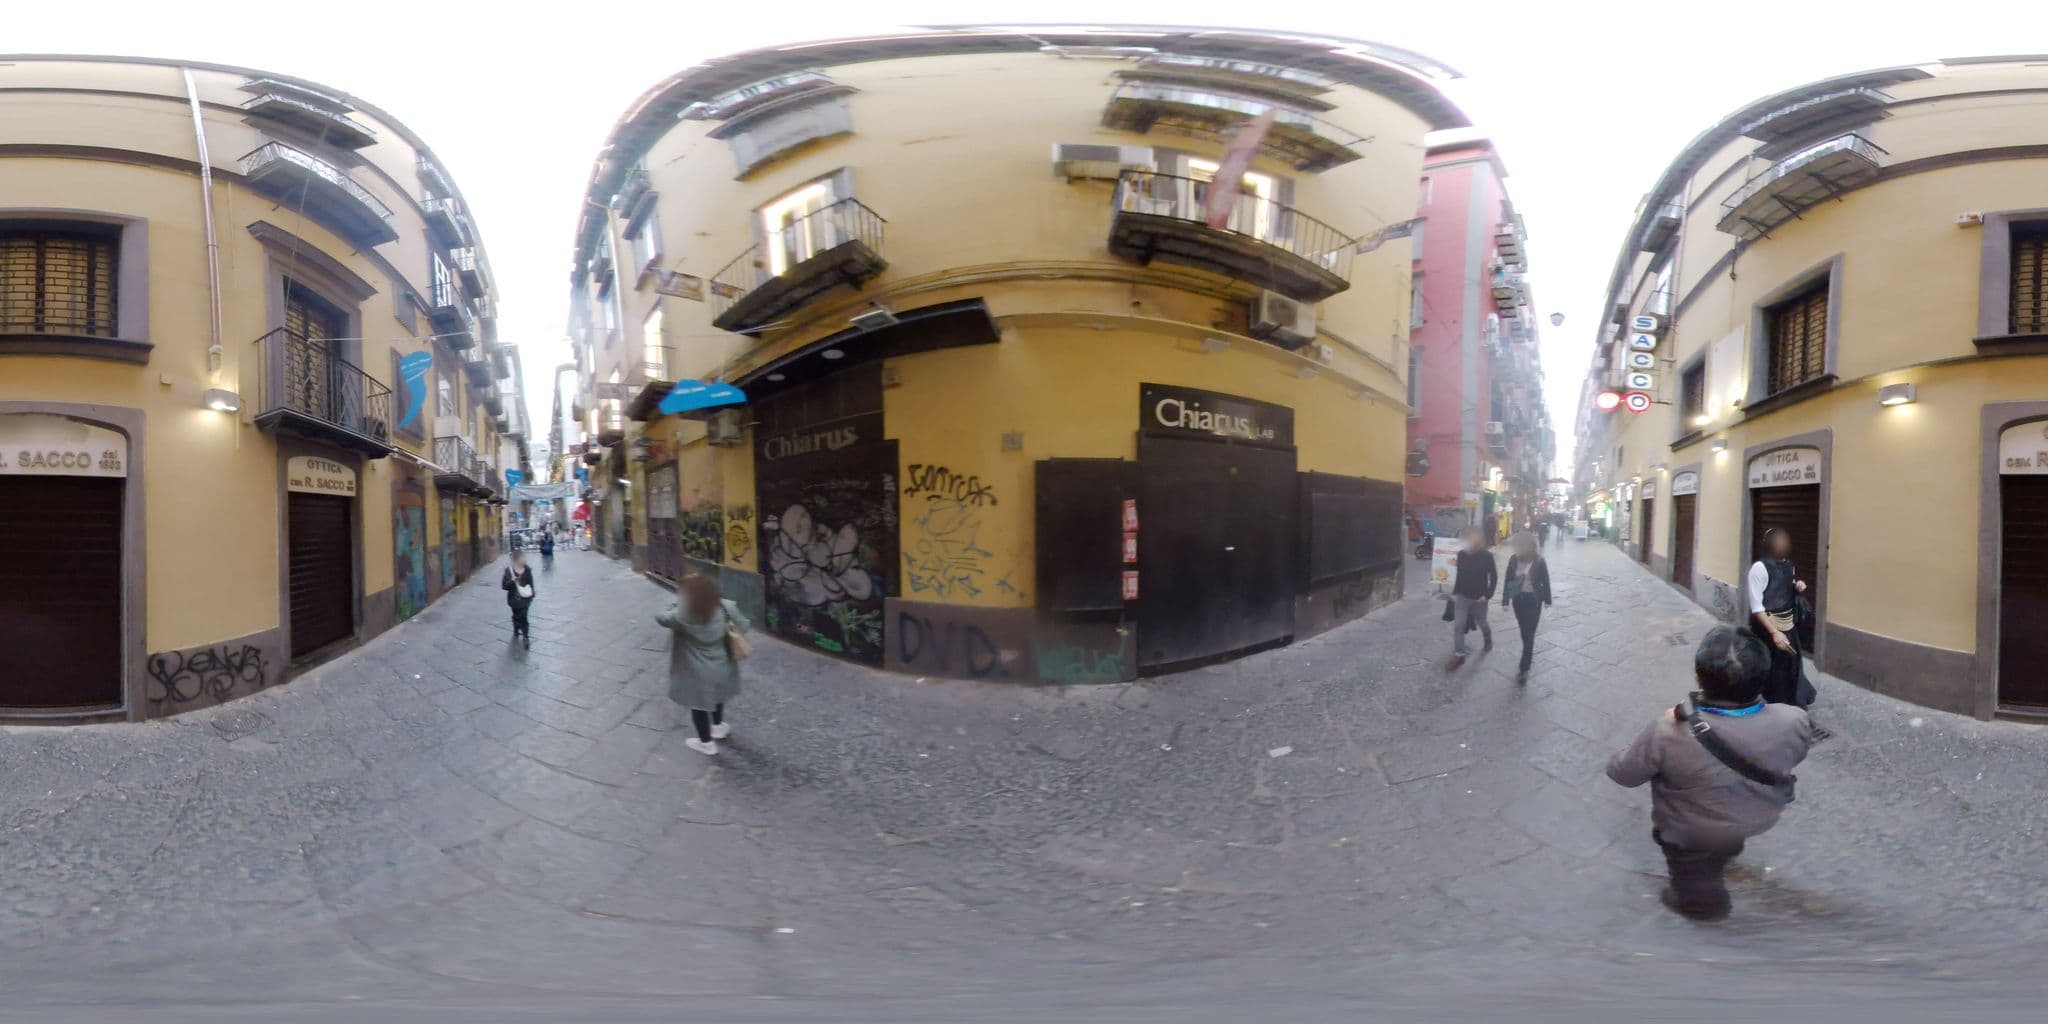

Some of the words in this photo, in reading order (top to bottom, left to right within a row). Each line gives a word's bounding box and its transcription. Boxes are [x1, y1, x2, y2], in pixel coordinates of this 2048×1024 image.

[1631, 317, 1653, 407] SACCO
[1155, 398, 1249, 433] Chiarus
[764, 426, 858, 460] Chiarus
[18, 450, 91, 468] SACCO
[307, 459, 342, 474] OTTICA
[317, 478, 344, 490] SACCO
